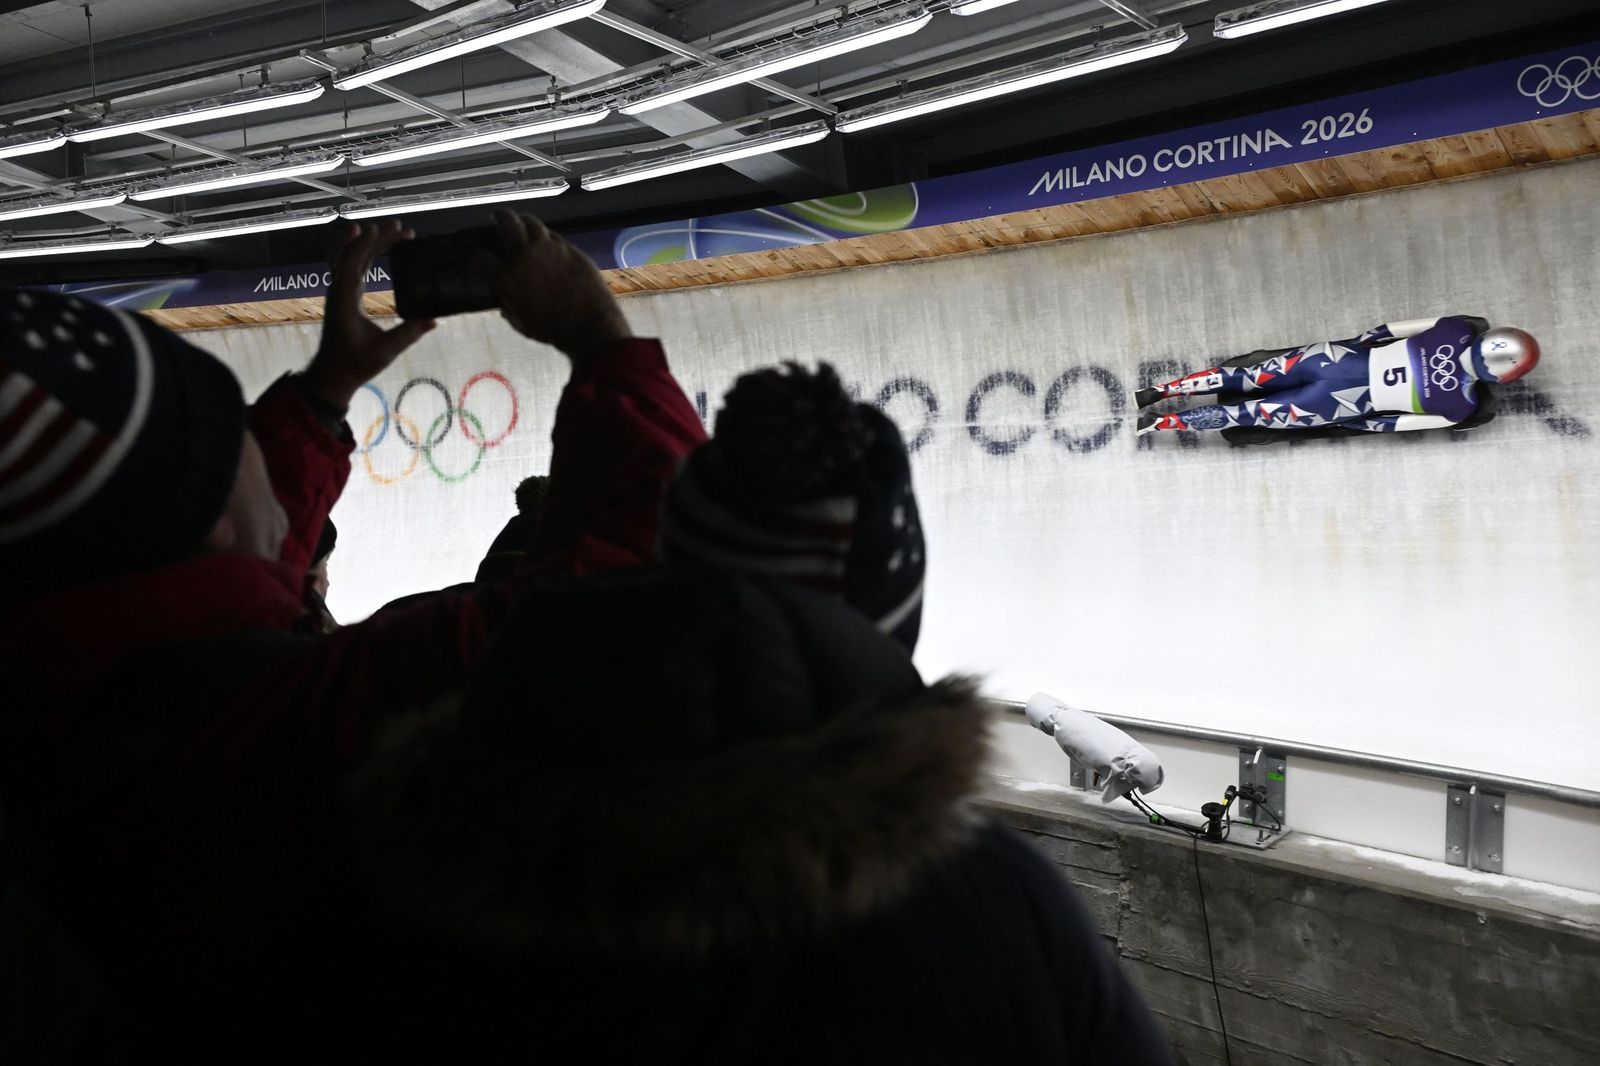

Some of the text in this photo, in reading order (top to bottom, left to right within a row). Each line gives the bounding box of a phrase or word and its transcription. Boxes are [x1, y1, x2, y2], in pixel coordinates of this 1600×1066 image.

[1028, 108, 1374, 196] MILANO CORTINA 2026
[253, 266, 391, 293] MILANO CINA
[1383, 366, 1407, 387] 5
